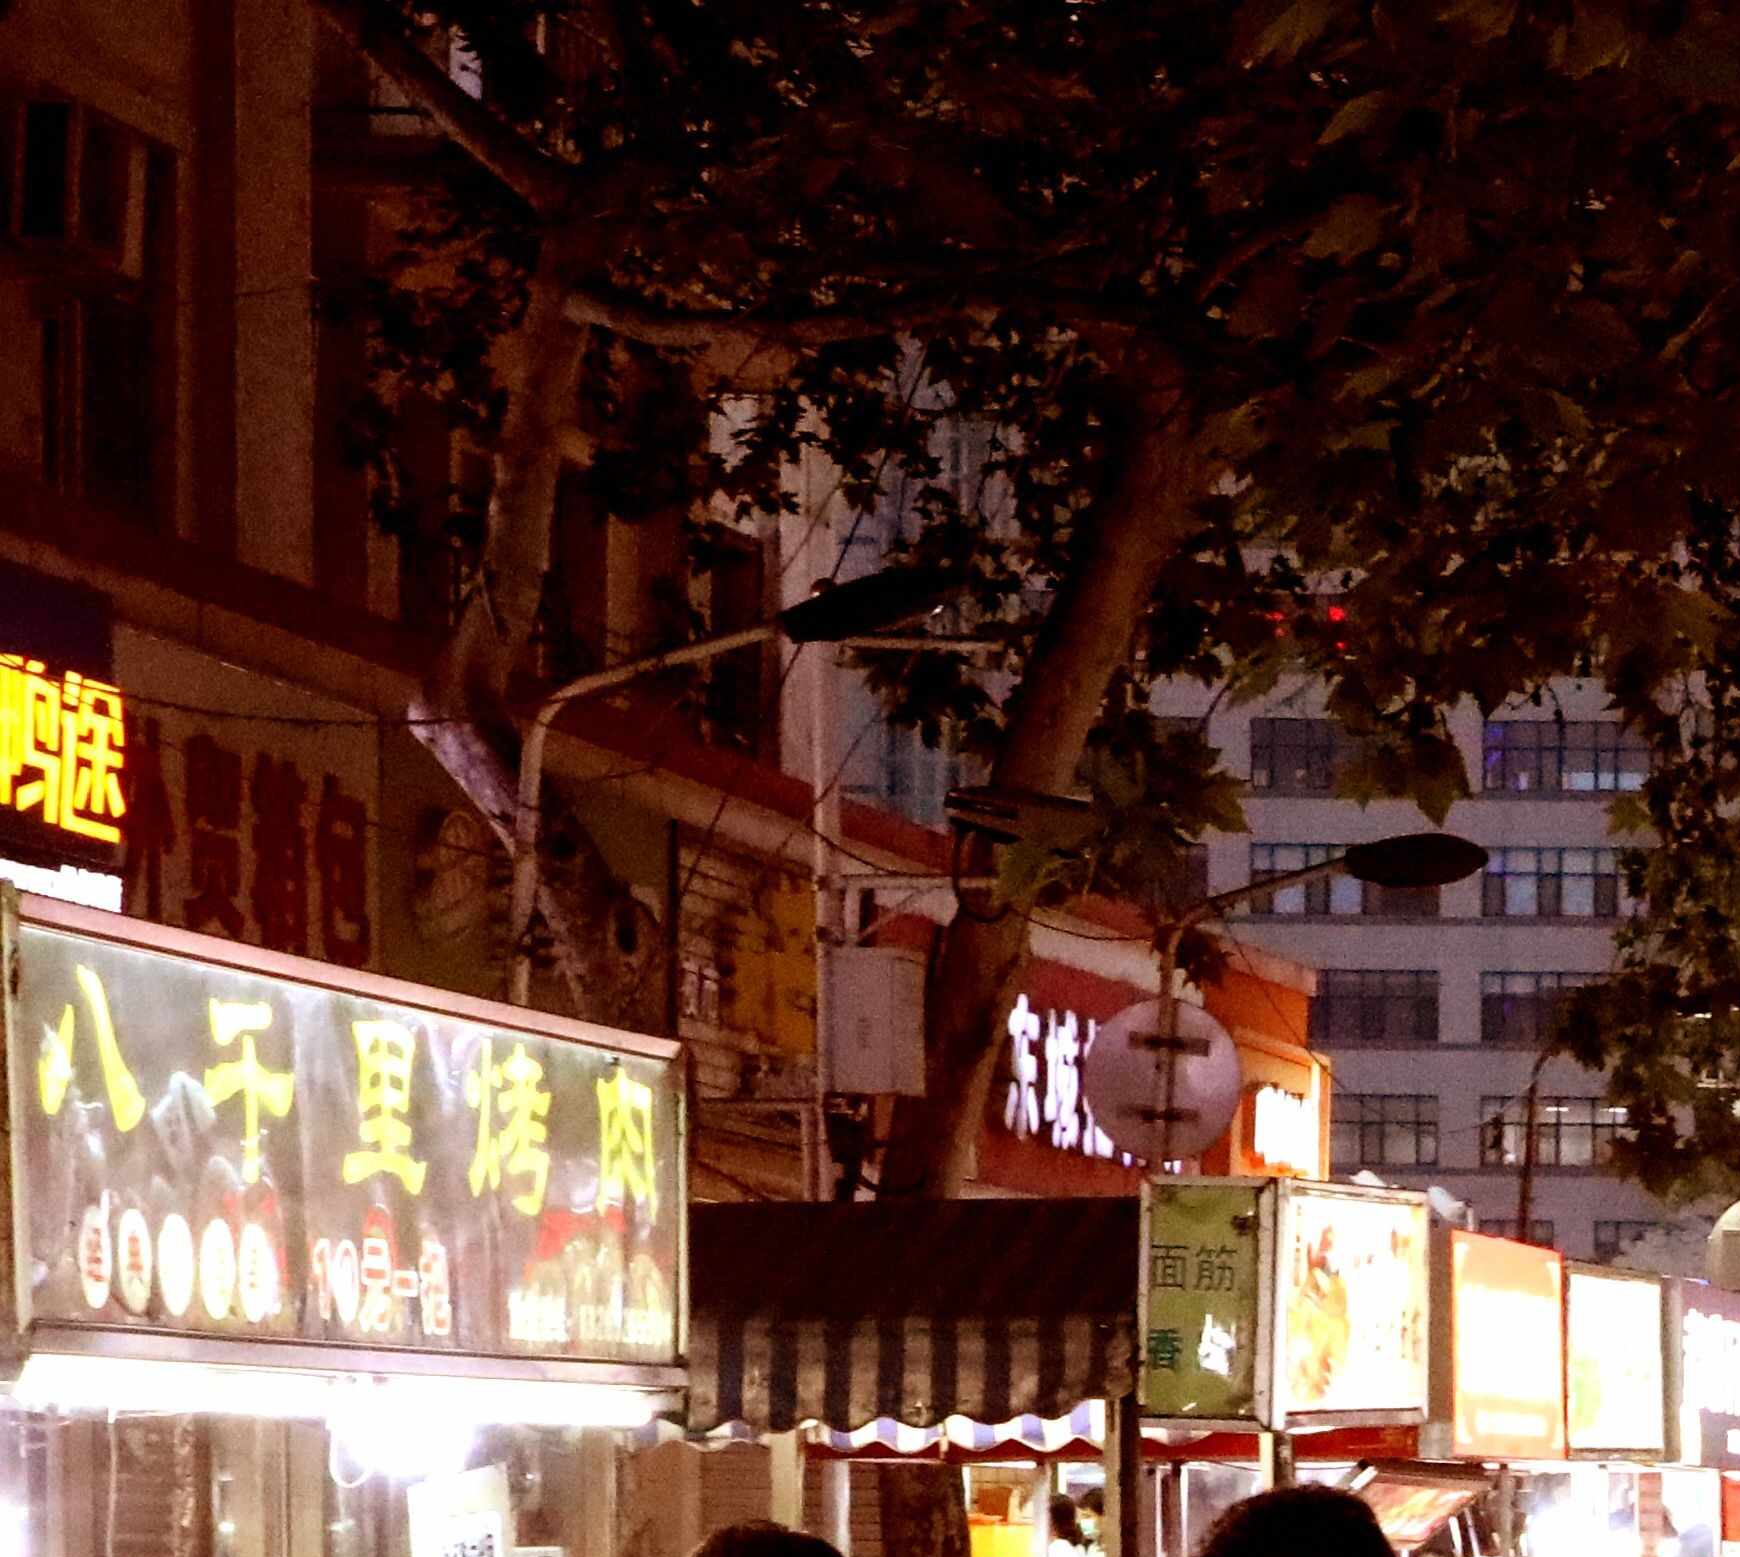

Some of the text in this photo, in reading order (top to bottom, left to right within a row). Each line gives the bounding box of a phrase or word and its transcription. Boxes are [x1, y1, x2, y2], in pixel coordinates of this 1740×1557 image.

[38, 963, 658, 1225] 八千里烤肉
[1149, 1244, 1238, 1294] 面筋
